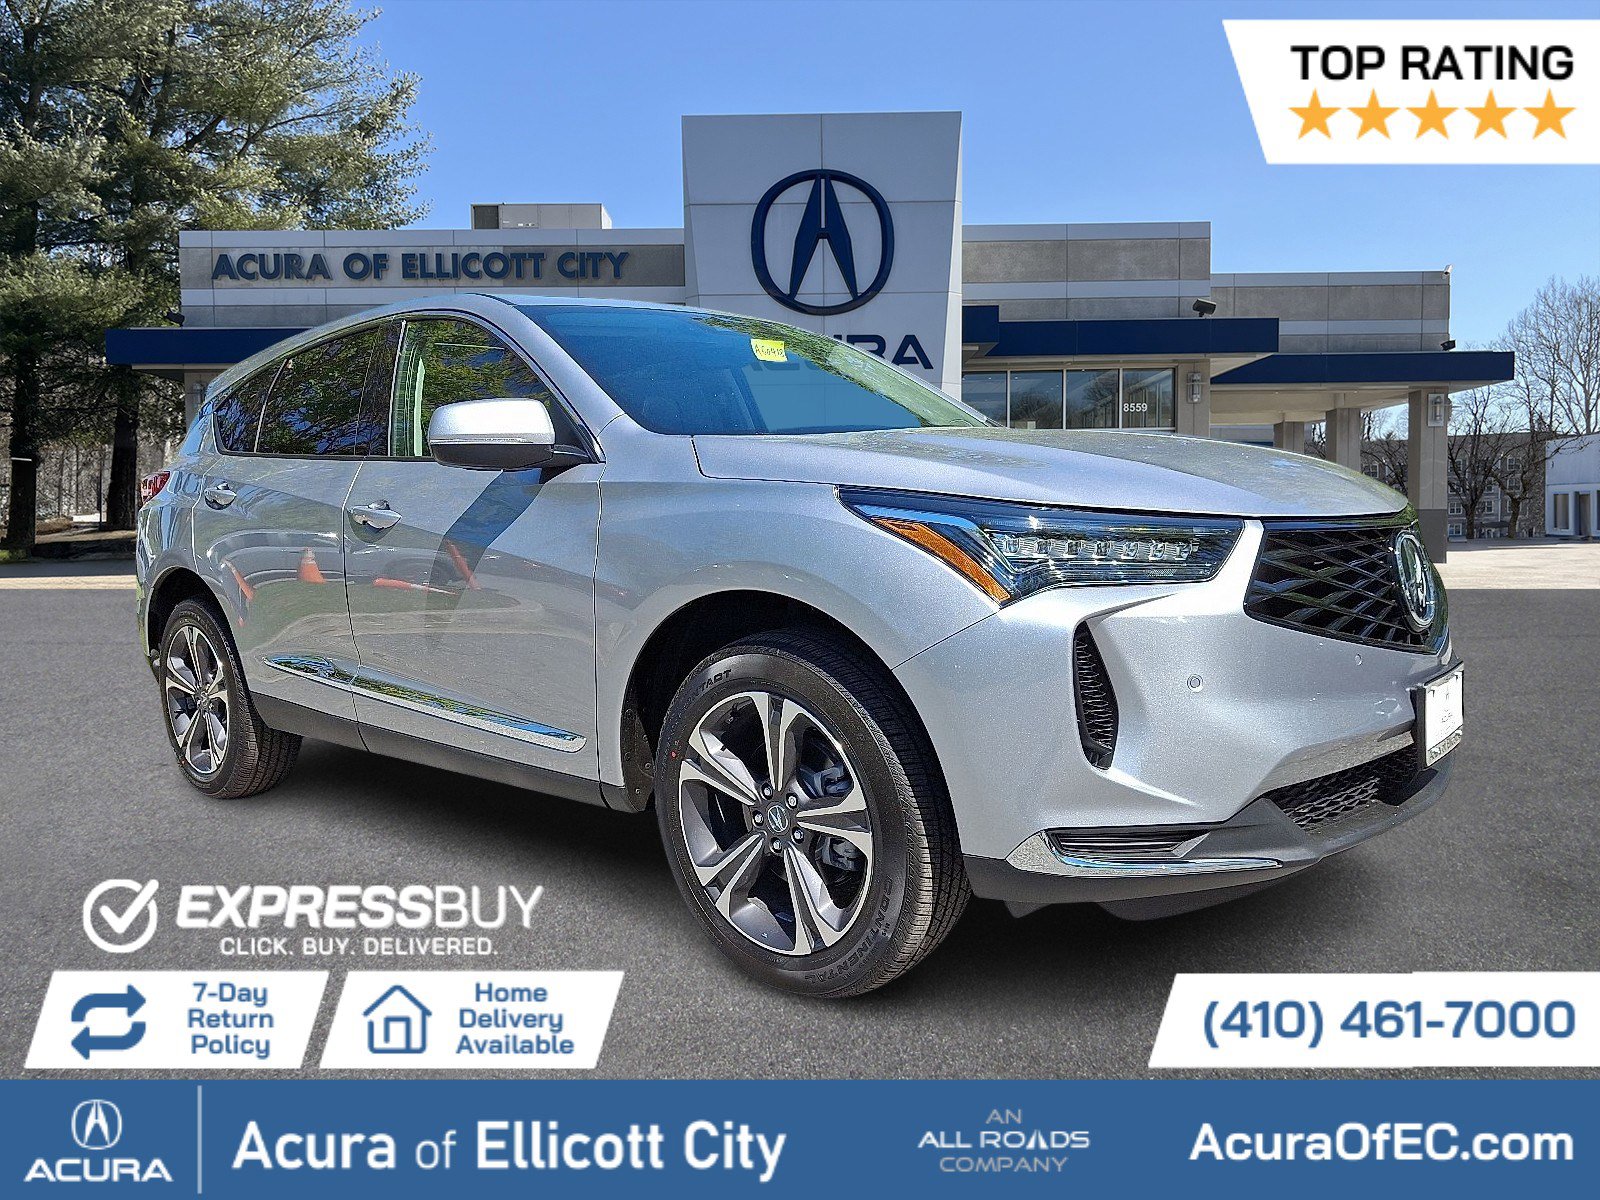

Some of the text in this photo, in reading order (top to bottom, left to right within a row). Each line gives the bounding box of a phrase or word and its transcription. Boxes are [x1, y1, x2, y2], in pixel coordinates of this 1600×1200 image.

[211, 251, 630, 281] ACURA OF ELLICOTT CITY
[1122, 402, 1148, 413] 8559
